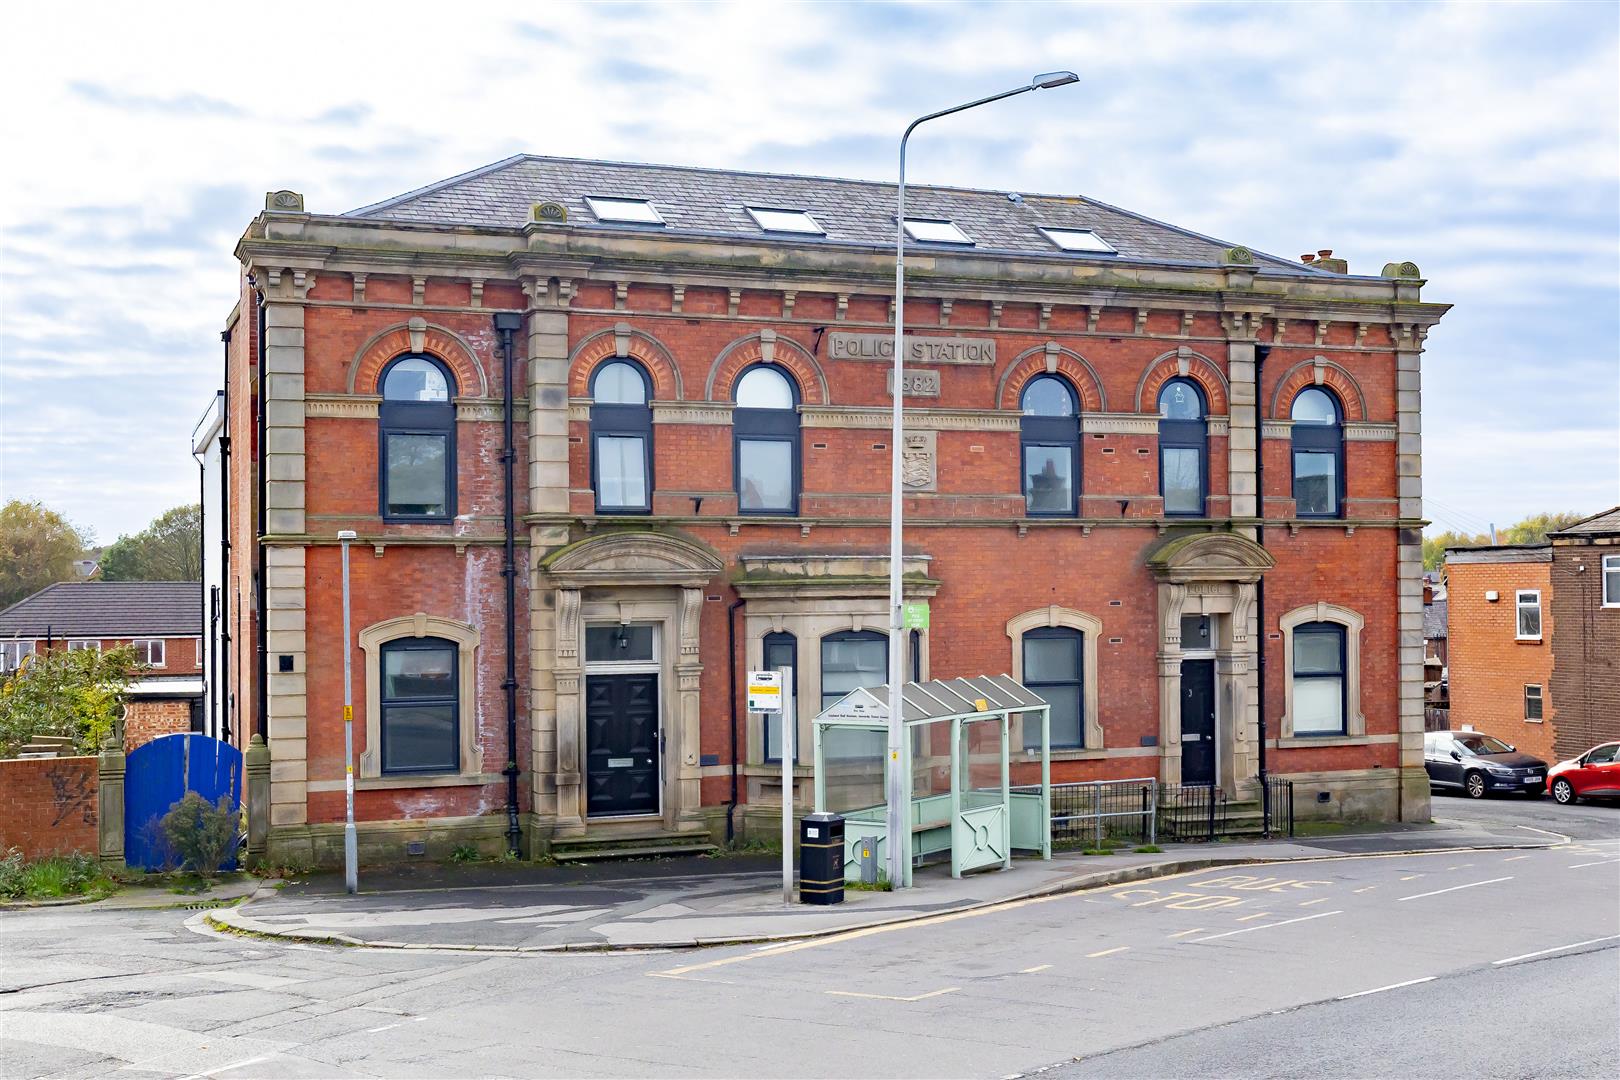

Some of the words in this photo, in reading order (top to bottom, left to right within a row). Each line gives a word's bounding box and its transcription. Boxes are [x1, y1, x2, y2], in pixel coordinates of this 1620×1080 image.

[833, 337, 898, 358] POLIC
[911, 341, 993, 362] STATION
[901, 376, 937, 394] 882
